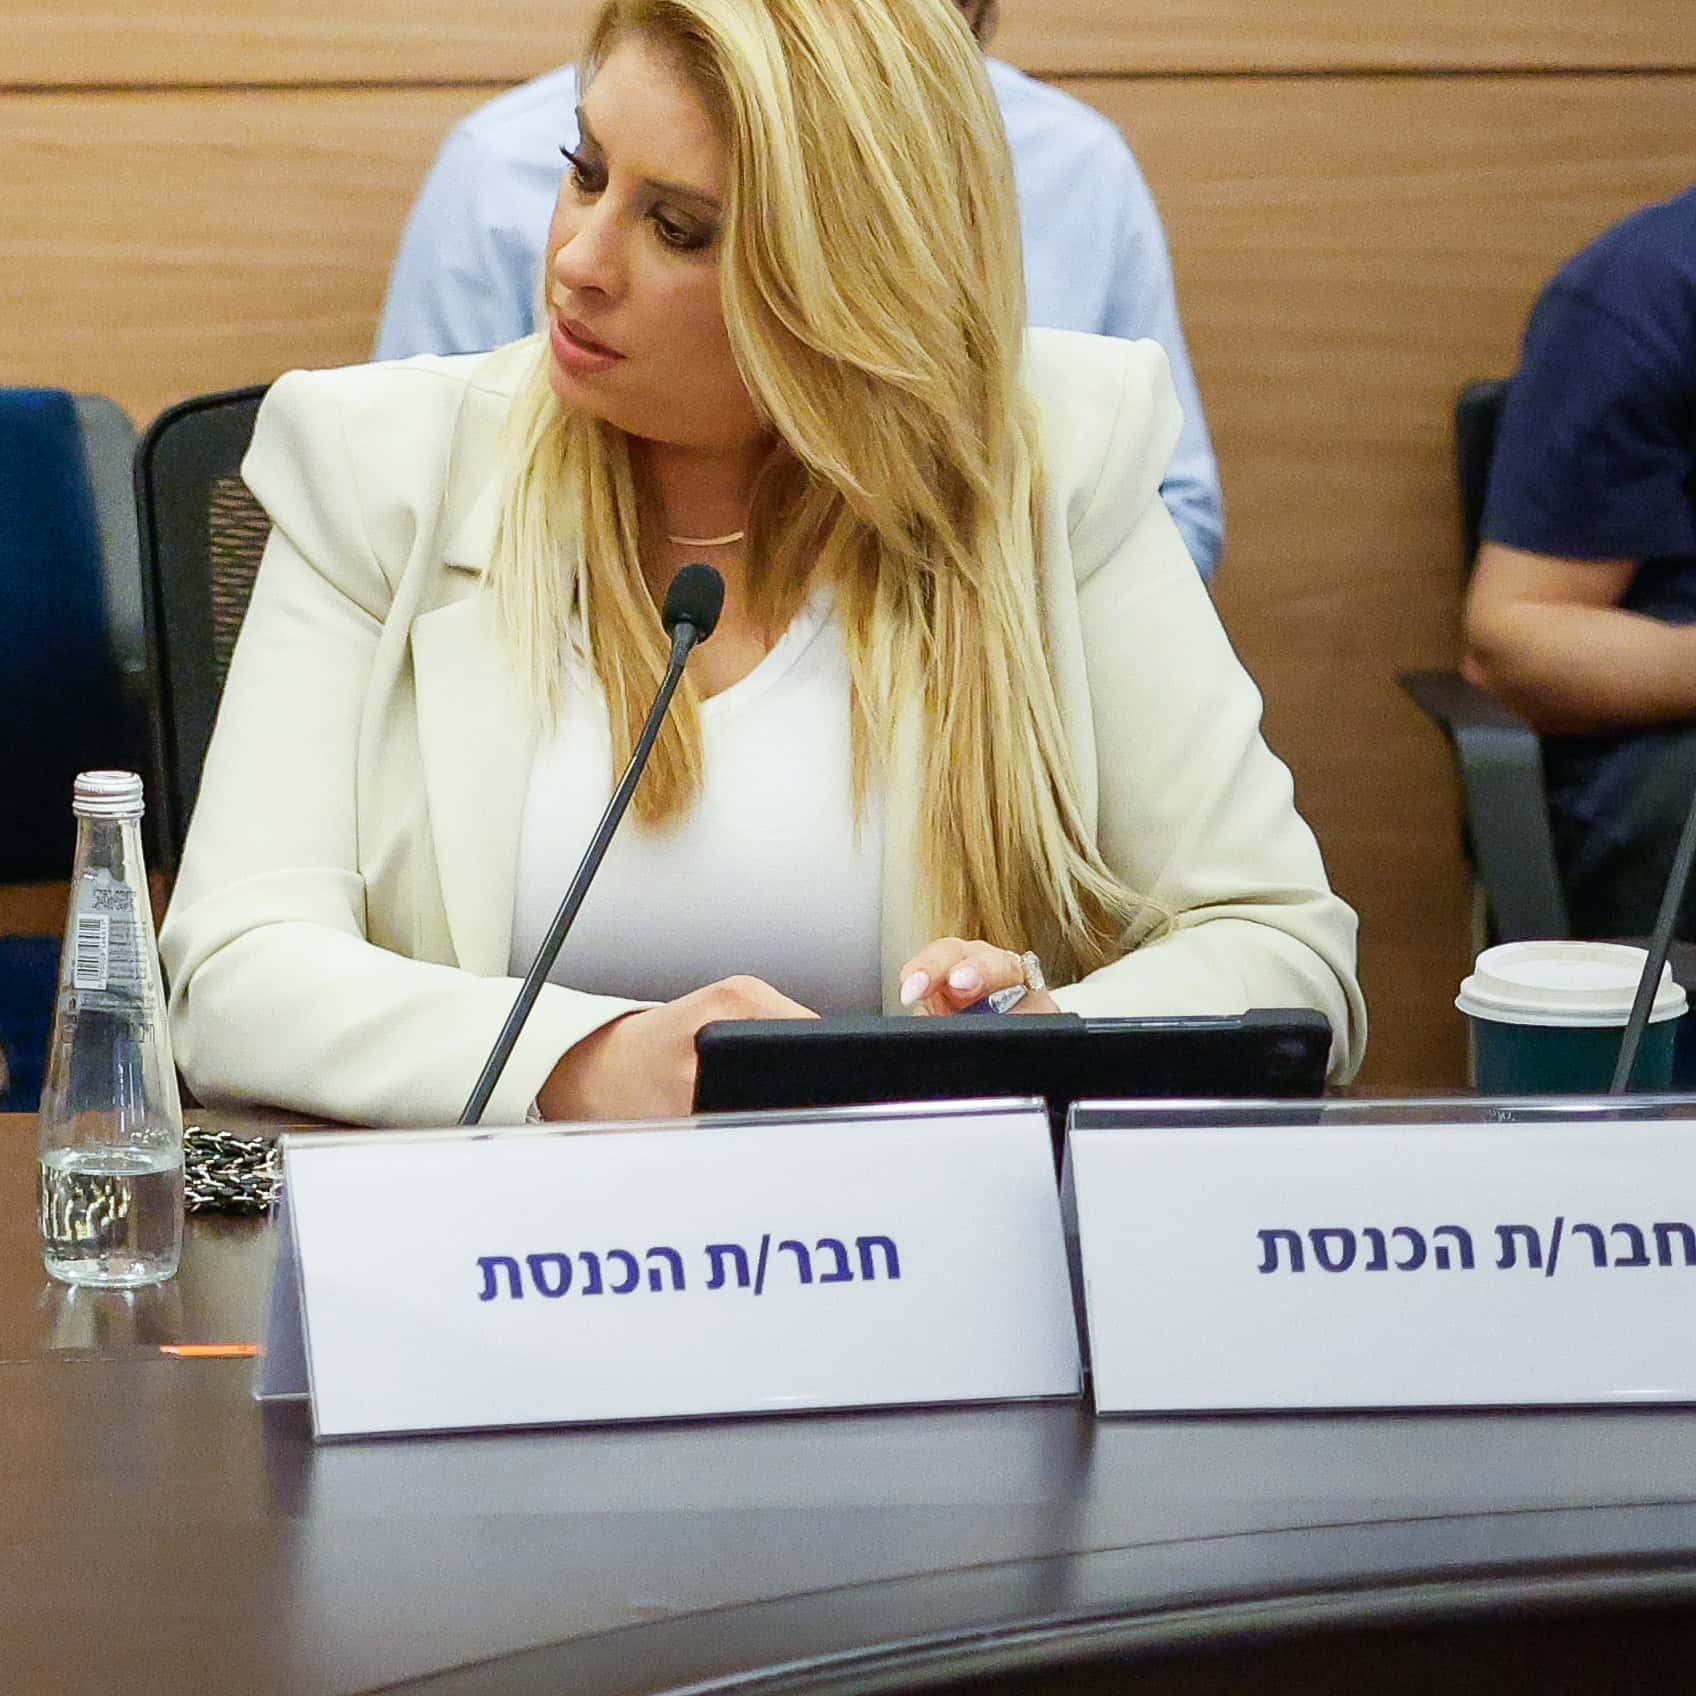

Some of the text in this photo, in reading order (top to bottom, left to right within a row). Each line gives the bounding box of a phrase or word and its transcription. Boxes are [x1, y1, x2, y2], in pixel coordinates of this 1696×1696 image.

[476, 1233, 901, 1302] חבר/ת הכנסת
[1257, 1216, 1696, 1278] חבר/ת הכנסת
